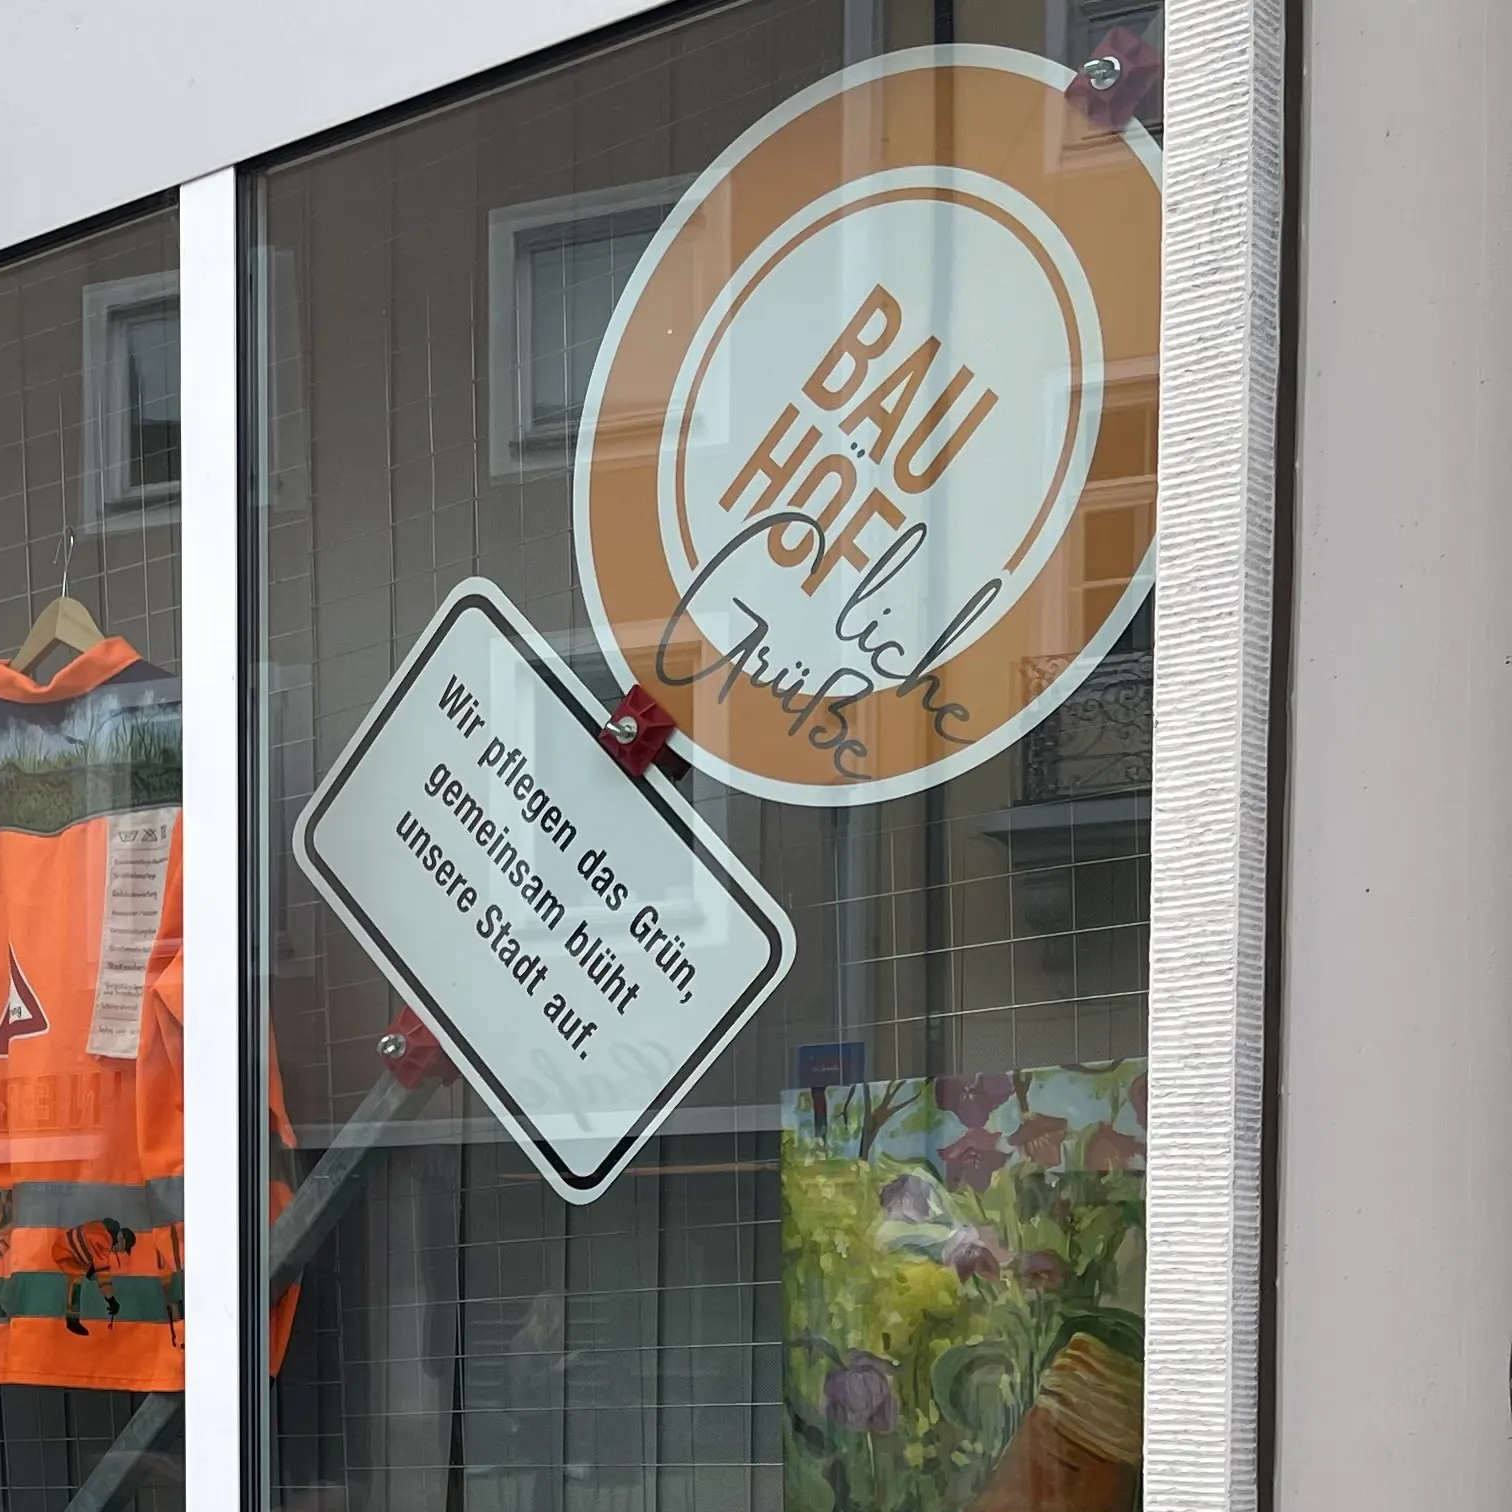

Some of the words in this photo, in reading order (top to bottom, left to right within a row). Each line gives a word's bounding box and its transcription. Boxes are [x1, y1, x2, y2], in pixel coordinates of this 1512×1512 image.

[801, 283, 999, 495] BAU
[655, 511, 872, 782] Grüße
[396, 810, 477, 914] unsere
[476, 904, 549, 998] Stadt
[543, 991, 599, 1061] auf.
[423, 762, 567, 932] gemeinsam
[565, 921, 641, 1016] blüht
[437, 673, 485, 741] Wir
[478, 735, 578, 853] pflegen
[577, 849, 628, 912] das
[630, 905, 697, 1005] Grün,
